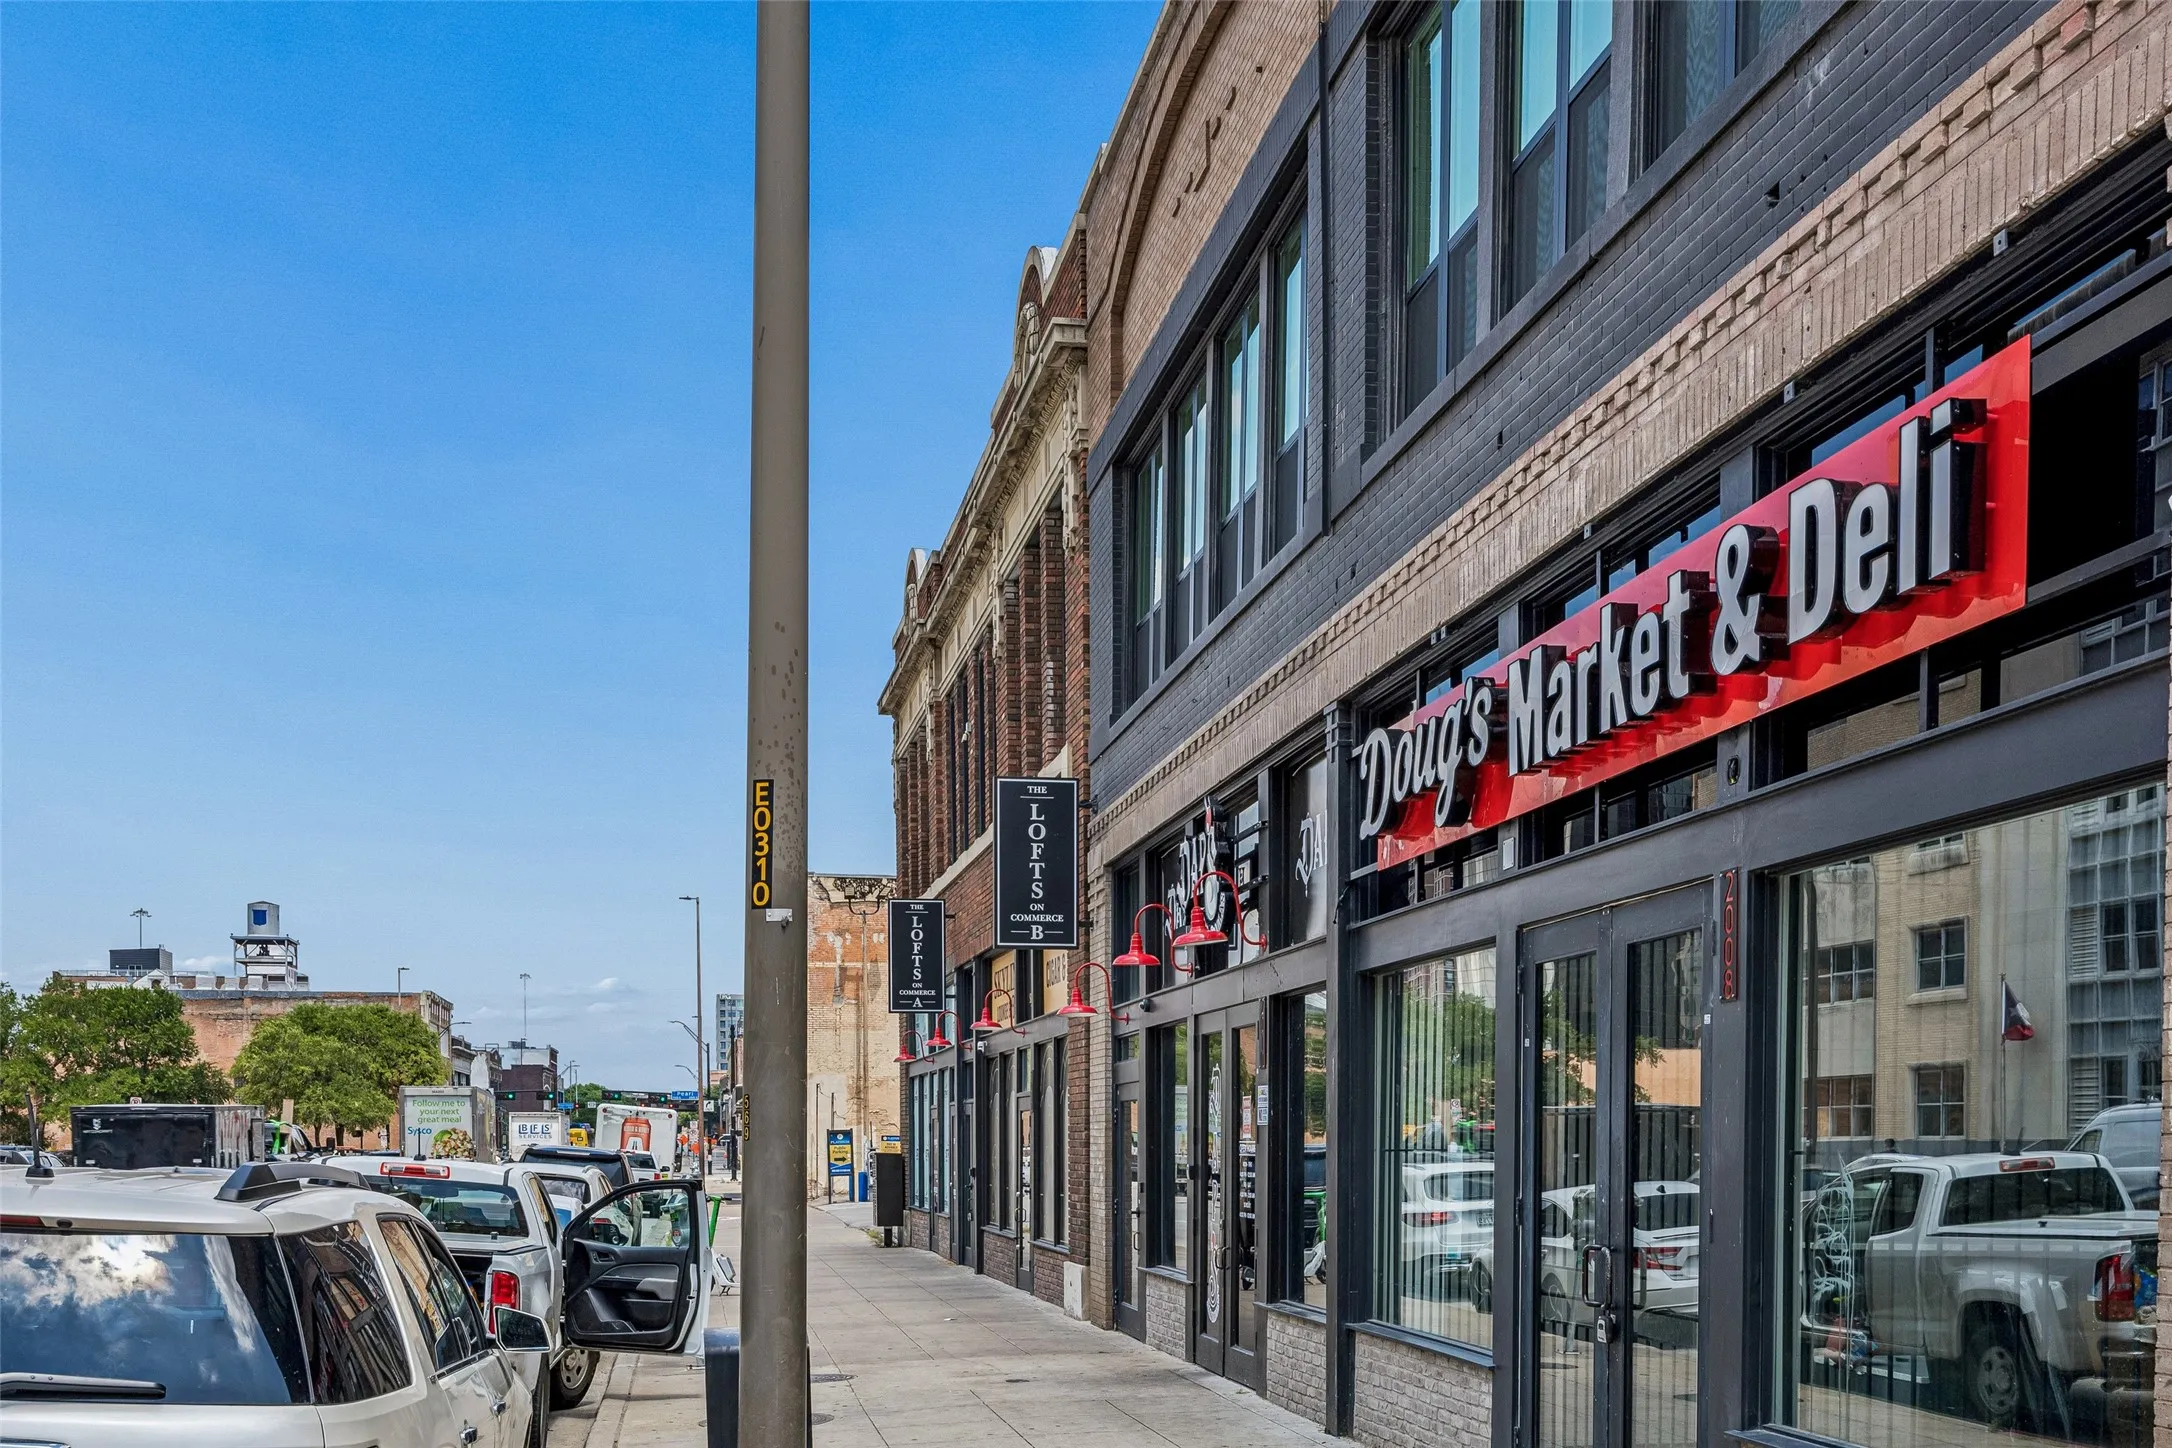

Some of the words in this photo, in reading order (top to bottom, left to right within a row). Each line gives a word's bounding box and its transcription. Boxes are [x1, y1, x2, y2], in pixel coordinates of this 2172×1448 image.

[1359, 676, 1493, 841] Doug's
[1507, 569, 1691, 778] Market
[1710, 522, 1762, 677] &
[1787, 398, 1955, 646] Deli
[1026, 785, 1048, 794] THE
[752, 781, 772, 907] E0310
[1027, 803, 1047, 900] LOFTS
[1294, 811, 1328, 899] DA
[1010, 913, 1065, 923] COMMERCE
[1029, 903, 1045, 912] ON
[910, 915, 924, 981] LOFTS
[1030, 924, 1045, 941] B
[1723, 871, 1735, 1000] 2008
[912, 996, 924, 1008] A
[408, 1126, 432, 1136] Sysco
